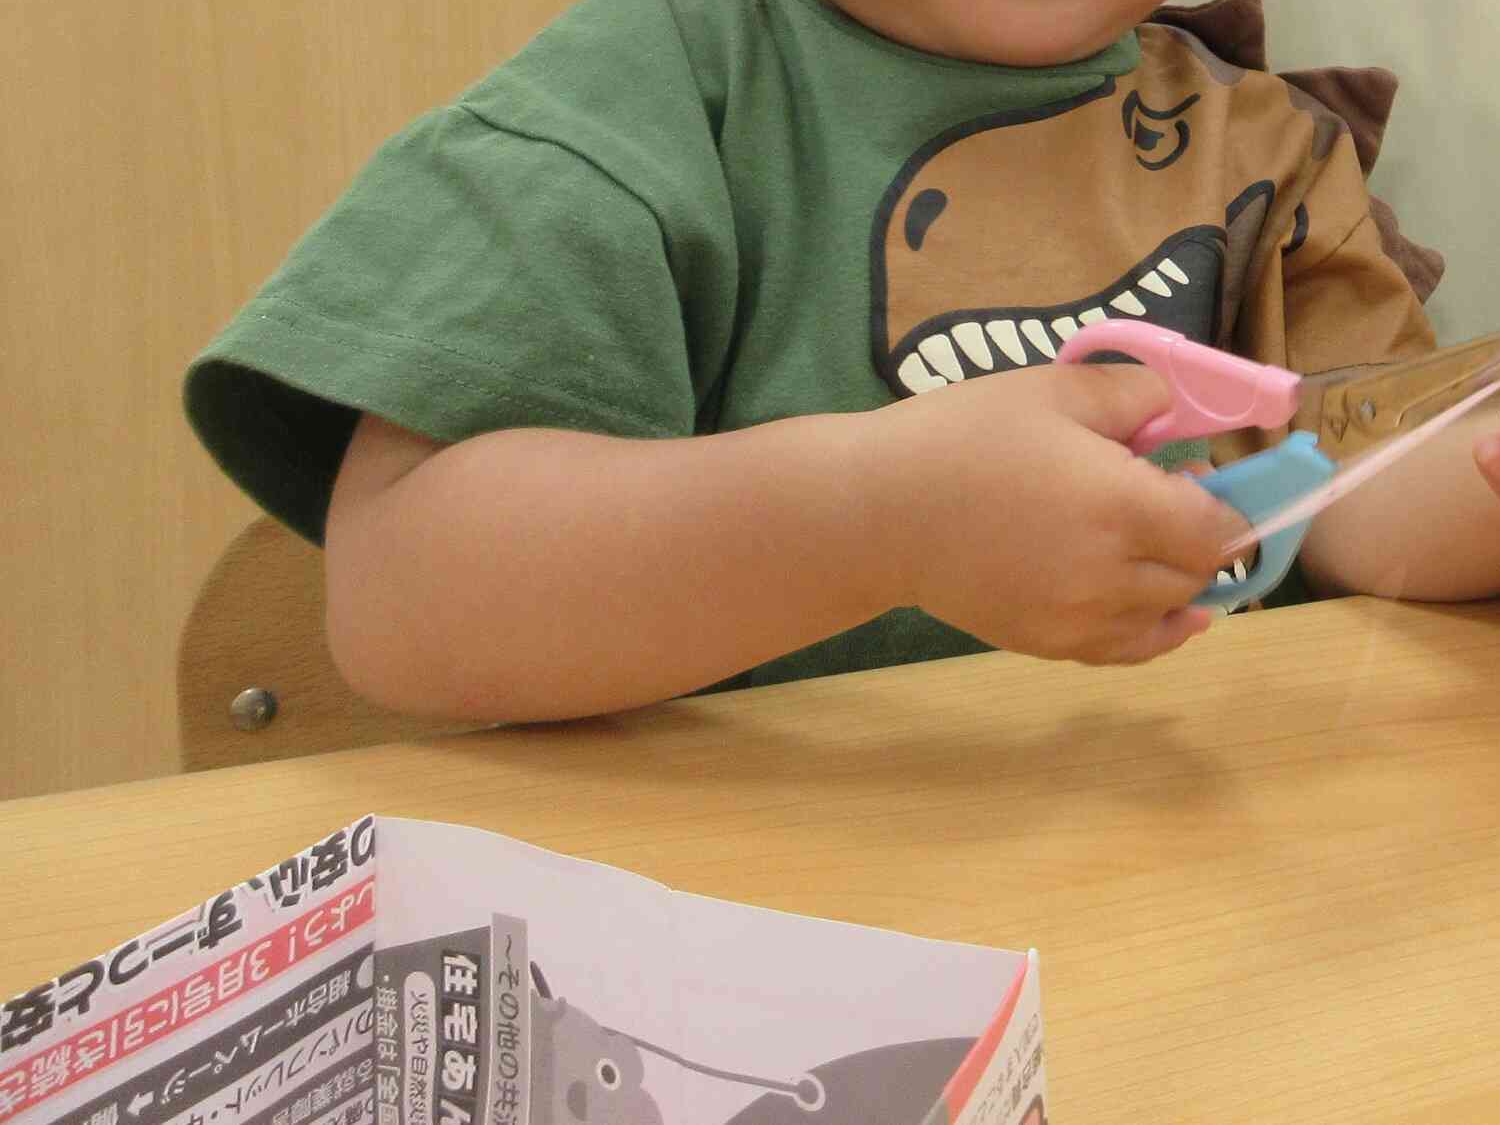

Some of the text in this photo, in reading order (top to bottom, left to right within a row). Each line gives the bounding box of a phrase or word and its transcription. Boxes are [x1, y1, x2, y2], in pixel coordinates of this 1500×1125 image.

[409, 990, 430, 1125] 火災や自然災
